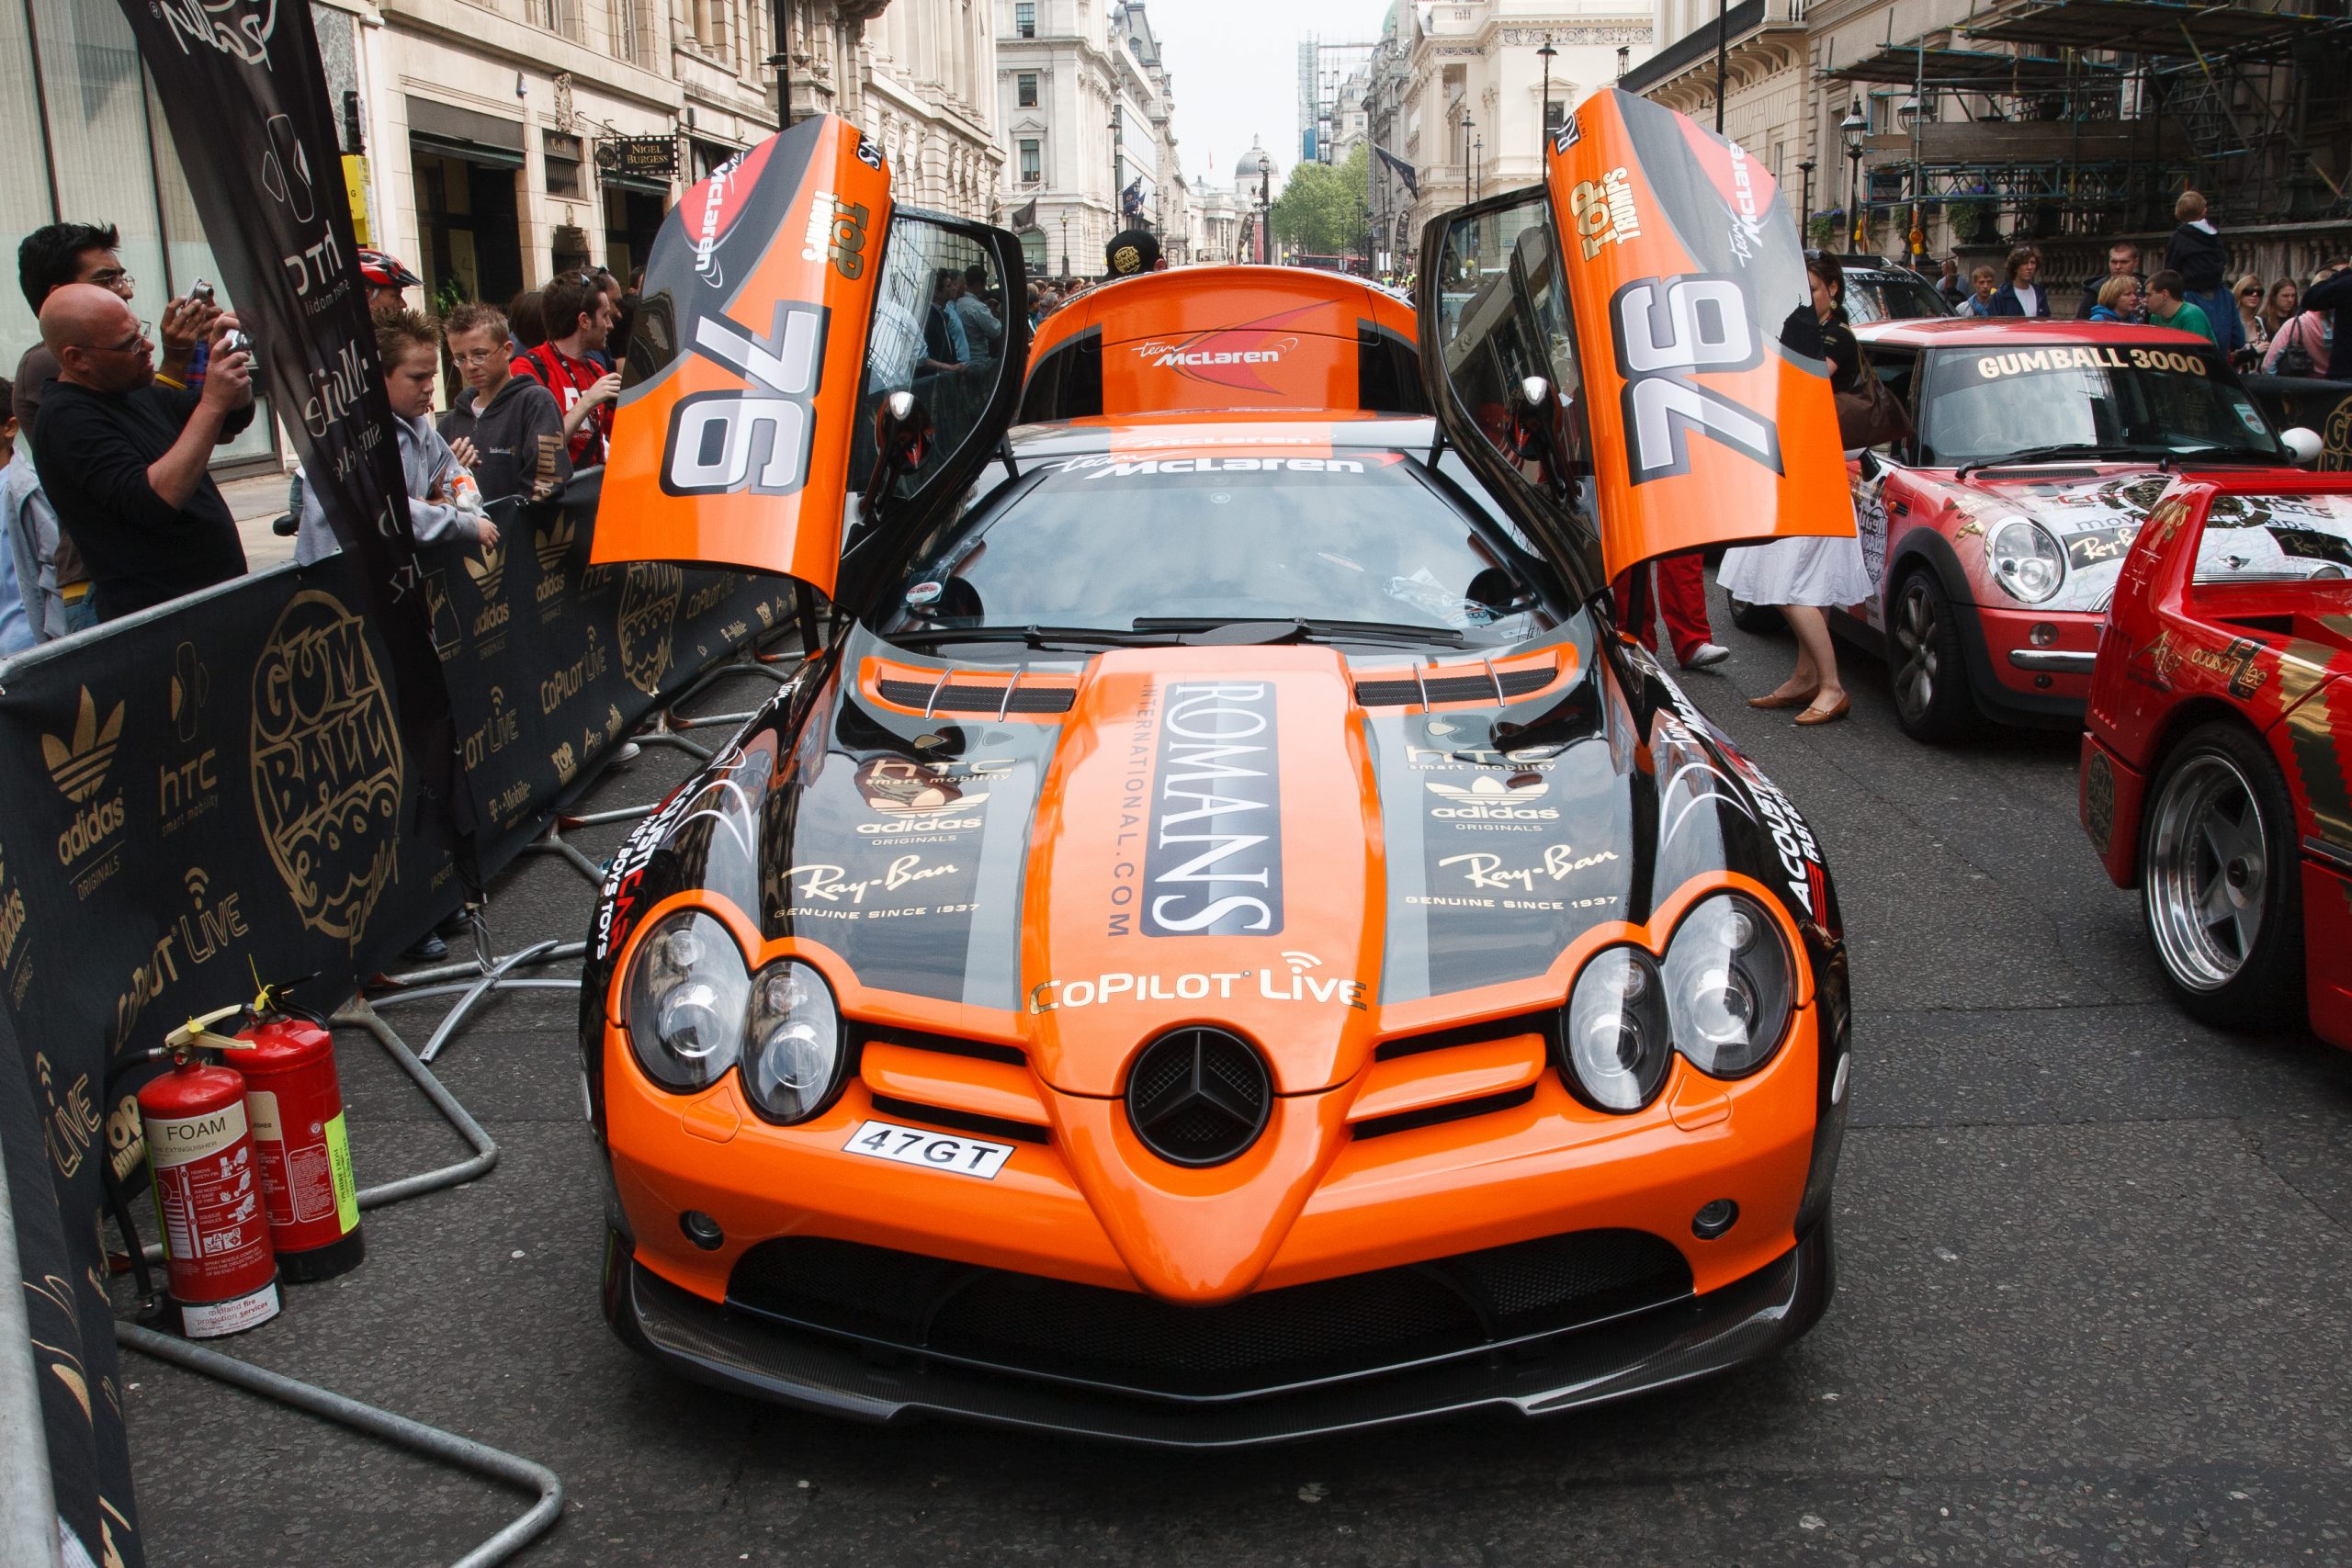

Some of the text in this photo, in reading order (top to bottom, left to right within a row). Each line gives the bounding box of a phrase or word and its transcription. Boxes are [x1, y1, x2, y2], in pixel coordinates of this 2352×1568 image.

[626, 153, 669, 164] BURGESS
[631, 143, 662, 154] NIGEL
[695, 162, 729, 272] McLaren
[1602, 166, 1643, 246] TRUMPS
[1569, 179, 1618, 263] TOP
[829, 201, 870, 281] TOP
[1131, 341, 1196, 358] team
[1151, 350, 1280, 367] McLaren
[1977, 346, 2208, 379] GUMBALL 3000
[1613, 276, 1781, 481] 76
[663, 304, 827, 493] 76
[1083, 458, 1365, 480] McLaren
[472, 601, 511, 637] adidas
[865, 772, 1012, 785] smart mobility
[1407, 762, 1558, 773] smart mobility
[1106, 682, 1160, 939] INTERNATIONAL.COM
[1151, 682, 1272, 932] ROMANS
[1430, 805, 1561, 820] adidas
[58, 793, 126, 867] adidas
[855, 816, 984, 835] adidas
[1454, 822, 1544, 833] ORIGINALS
[871, 834, 958, 847] ORIGINALS
[604, 846, 630, 897] BOYS
[780, 853, 960, 905] Ray-Ban
[1438, 843, 1620, 893] Ray-Ban
[773, 902, 982, 920] GENUINE SINCE 1937
[1404, 895, 1619, 911] GENUINE SINCE 1937
[595, 903, 615, 961] TOYS
[165, 1116, 227, 1141] FOAM
[164, 1140, 218, 1154] EXTINGUISHER
[859, 1129, 1001, 1171] 47GT
[208, 1298, 256, 1316] midland fire
[239, 1301, 268, 1318] services
